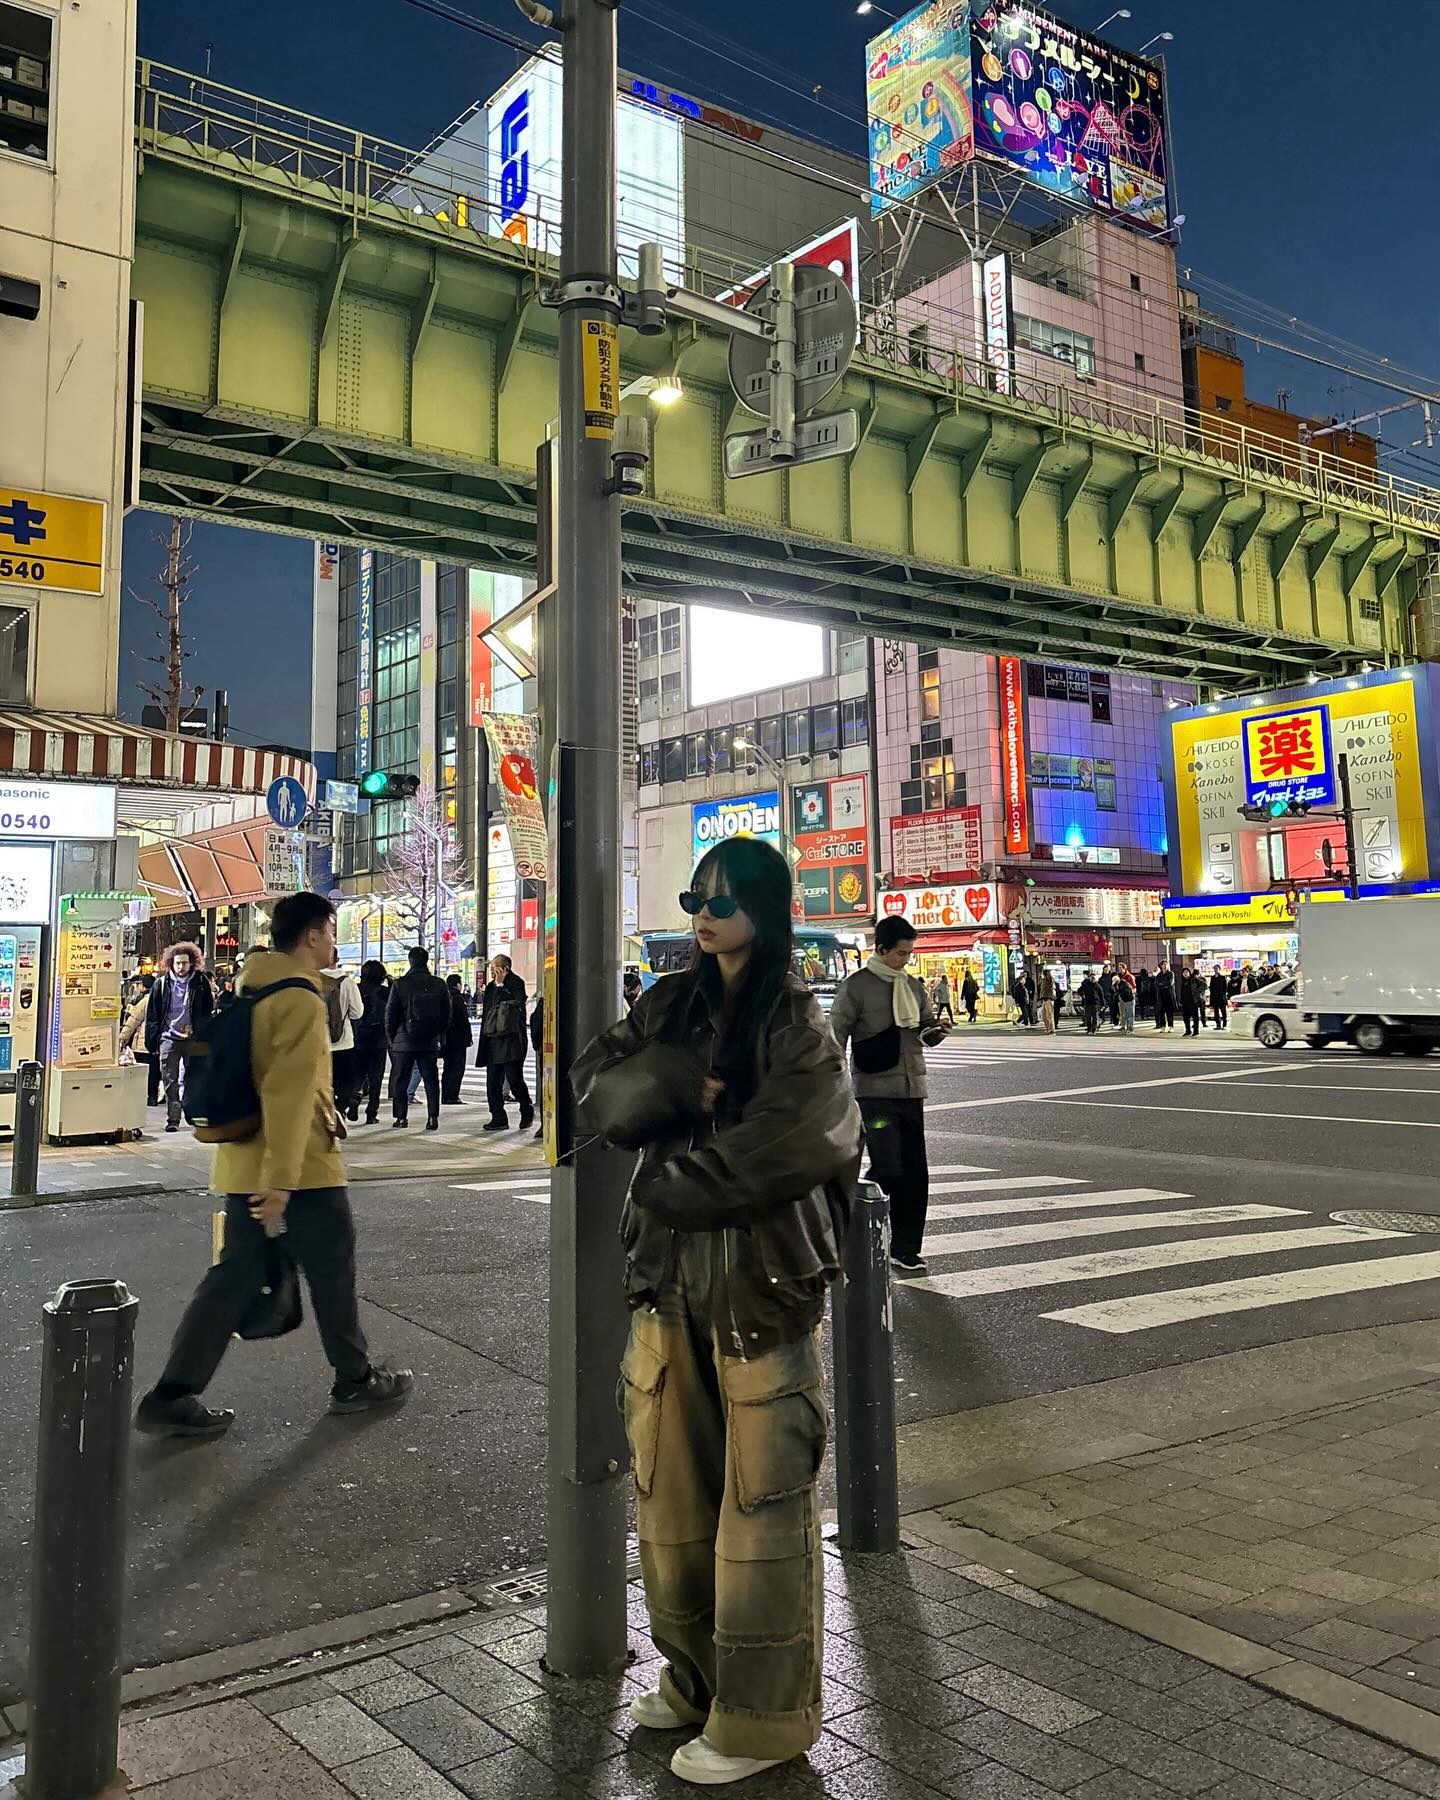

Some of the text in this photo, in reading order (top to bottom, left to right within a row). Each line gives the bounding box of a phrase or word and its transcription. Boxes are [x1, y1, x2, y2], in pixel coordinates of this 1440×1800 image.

[1012, 4, 1079, 46] AMUSEMENT
[1080, 38, 1109, 60] PARK
[989, 271, 1004, 330] ADULT
[0, 559, 45, 581] 540
[1339, 712, 1408, 733] SHISEIDO
[1257, 716, 1316, 778] 薬
[1368, 731, 1406, 747] KOSÉ
[1006, 661, 1022, 843] www.akibalovemerci.com
[1181, 740, 1239, 757] SHISEIDO
[1206, 757, 1236, 770] KOSÉ
[1350, 750, 1402, 768] Kanebo
[1190, 774, 1235, 789] Kanebo
[1268, 777, 1308, 789] DRUG STORE
[1354, 768, 1402, 785] SOFINA
[1193, 791, 1233, 805] SOFINA
[1366, 785, 1392, 801] SK-II
[1, 813, 50, 829] 0540
[1203, 806, 1225, 820] SK-II
[696, 806, 779, 841] ONODEN
[816, 834, 847, 845] ジーストア
[915, 891, 957, 910] LOVE
[1032, 896, 1085, 908] 大人の通信販売
[1177, 910, 1252, 922] Matsumoto KiYoshi
